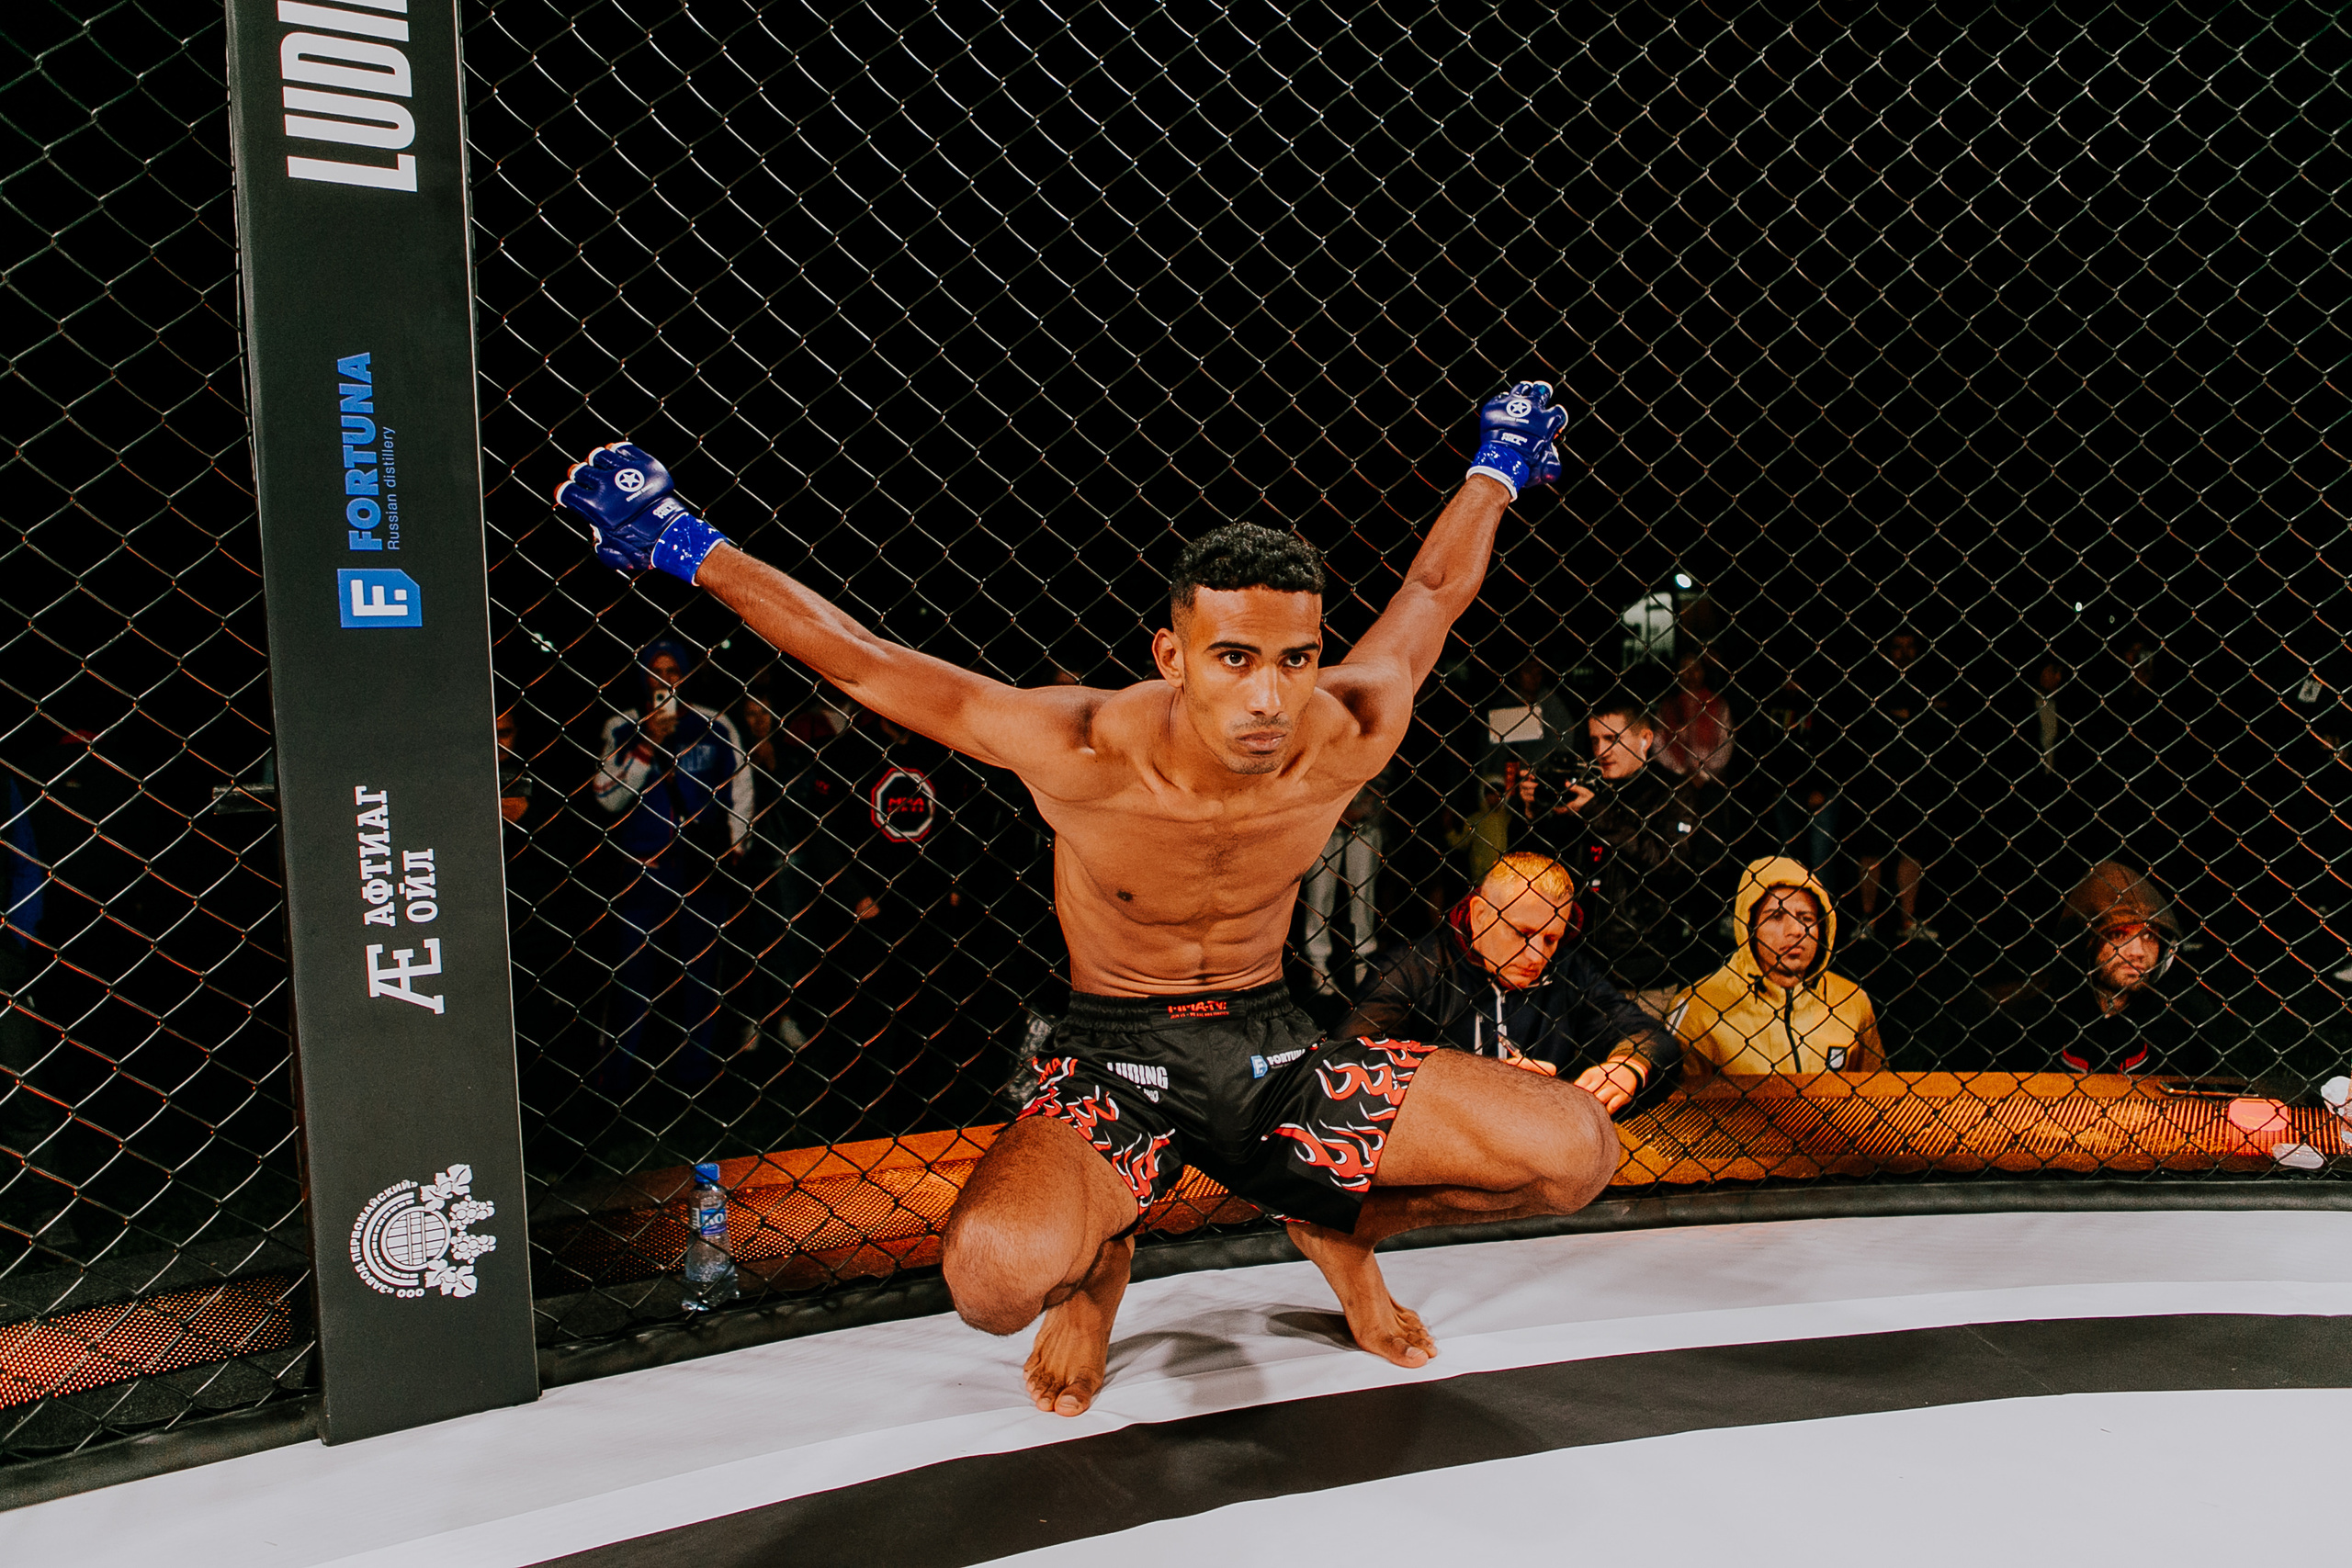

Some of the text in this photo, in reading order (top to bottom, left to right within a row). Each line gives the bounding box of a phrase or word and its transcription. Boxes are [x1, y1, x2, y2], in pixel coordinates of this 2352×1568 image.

[336, 352, 383, 551] FORTUNA
[381, 426, 401, 550] Russian distillery
[355, 785, 396, 927] АФТИАГ
[398, 848, 438, 923] ОЙЛ
[349, 1179, 418, 1263] ПЕРВОМАЙСКИЙ»
[395, 1288, 425, 1298] ООО
